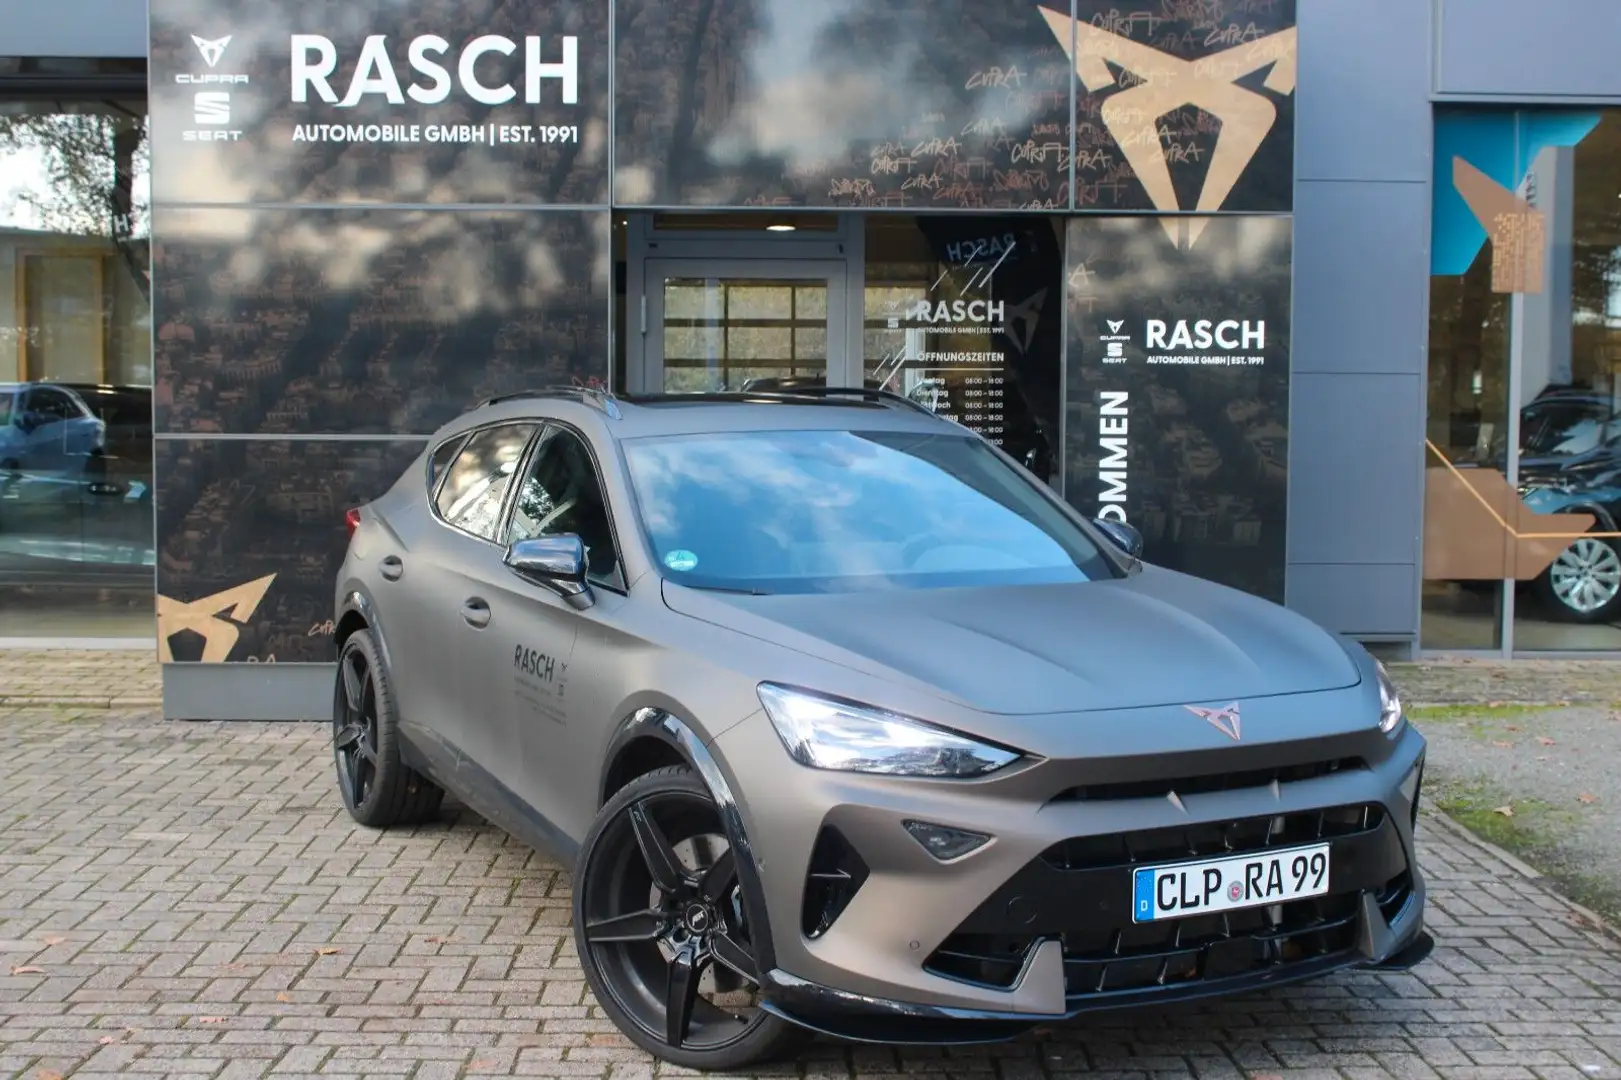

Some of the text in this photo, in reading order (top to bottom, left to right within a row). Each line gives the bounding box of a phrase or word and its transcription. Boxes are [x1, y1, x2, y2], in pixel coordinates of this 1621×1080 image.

[175, 74, 249, 84] CUPRA
[291, 34, 578, 107] RASCH
[182, 130, 243, 141] SEAT
[292, 125, 420, 143] AUTOMOBILE
[425, 126, 485, 143] GMBH
[500, 126, 535, 143] EST.
[541, 126, 578, 143] 1991
[916, 299, 1004, 323] RASCH
[1146, 319, 1265, 350] RASCH
[1146, 355, 1200, 365] AUTOMOBILE
[1201, 356, 1226, 365] GMBH
[1231, 356, 1247, 365] EST.
[1247, 356, 1264, 365] 1991
[514, 644, 555, 682] RASCH
[1157, 852, 1326, 911] CLP RA 99
